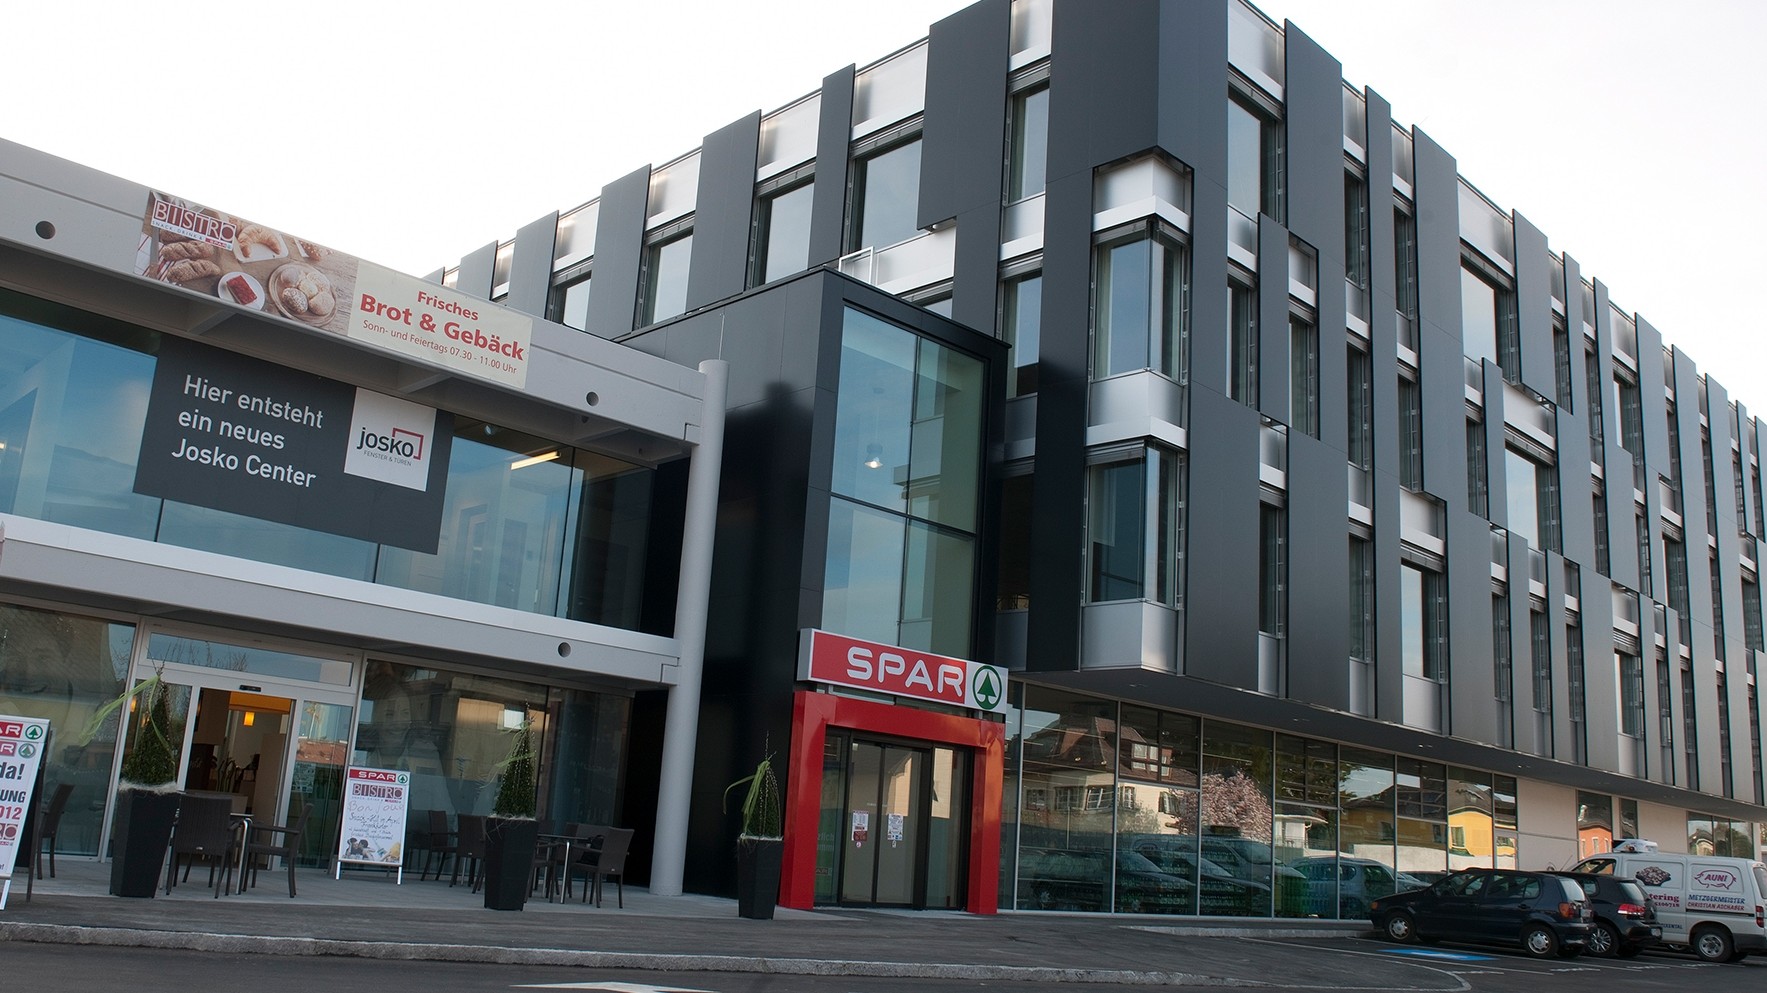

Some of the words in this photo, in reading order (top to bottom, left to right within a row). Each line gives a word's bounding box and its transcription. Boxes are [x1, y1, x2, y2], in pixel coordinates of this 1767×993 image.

[154, 201, 235, 243] BISTRO
[417, 290, 479, 321] Frisches
[360, 293, 413, 326] Brot
[419, 313, 437, 333] &
[443, 321, 524, 361] Gebäck
[362, 319, 389, 334] Sonn-
[390, 330, 409, 341] und
[409, 334, 448, 355] Feiertags
[449, 346, 473, 361] 07.30
[480, 355, 501, 370] 11.00
[502, 362, 518, 375] Uhr
[183, 374, 233, 405] Hier
[237, 393, 324, 430] entsteht
[178, 408, 212, 433] ein
[219, 418, 285, 450] neues
[356, 427, 414, 458] josko
[171, 438, 239, 471] Josko
[245, 454, 317, 489] Center
[363, 450, 388, 461] FENSTER
[846, 646, 964, 698] SPAR
[353, 783, 403, 800] BISTRO
[358, 771, 396, 781] SPAR
[0, 789, 26, 803] UNG
[1704, 873, 1728, 882] AUNI
[1687, 901, 1716, 909] CHRISTIAN
[1688, 894, 1746, 904] METZGERMEISTER
